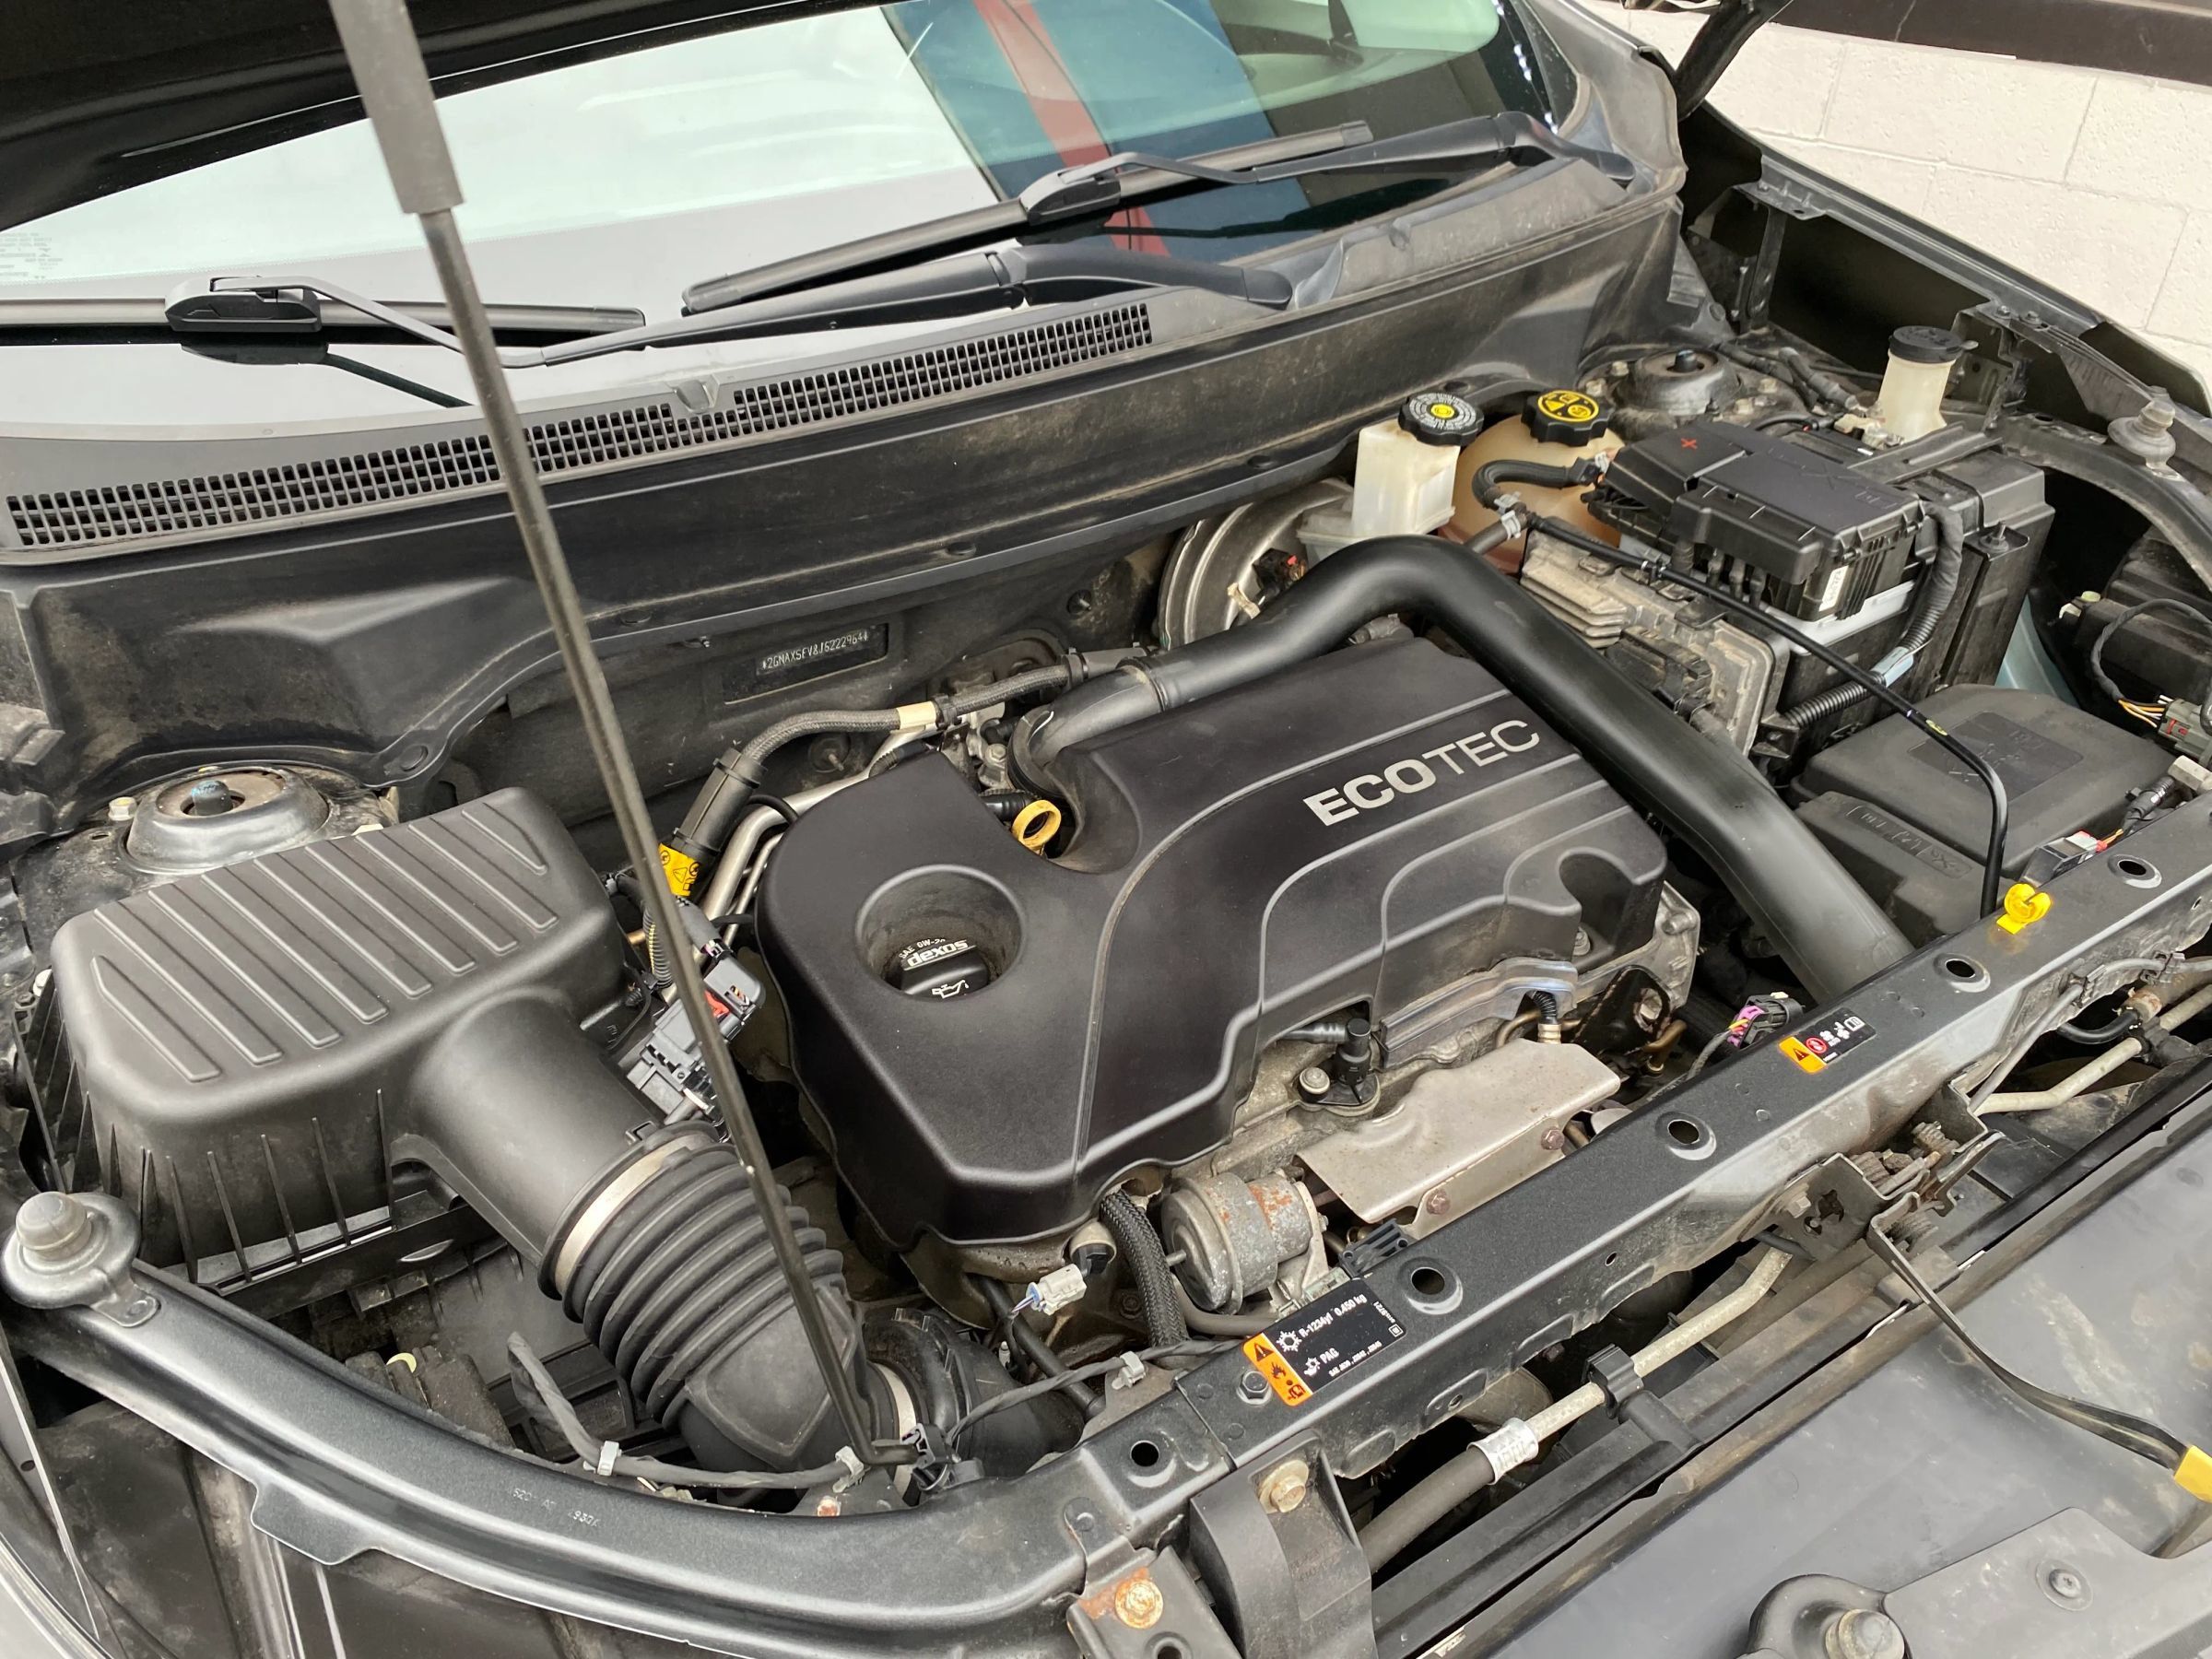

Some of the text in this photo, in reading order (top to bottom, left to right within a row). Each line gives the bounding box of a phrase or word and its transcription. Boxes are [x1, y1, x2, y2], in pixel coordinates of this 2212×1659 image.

[1302, 720, 1540, 827] ECOTEC
[899, 946, 915, 959] SAE
[907, 940, 969, 966] dexos
[1334, 1299, 1356, 1316] 0.450
[1353, 1294, 1368, 1305] kg
[1319, 1347, 1340, 1364] PAG
